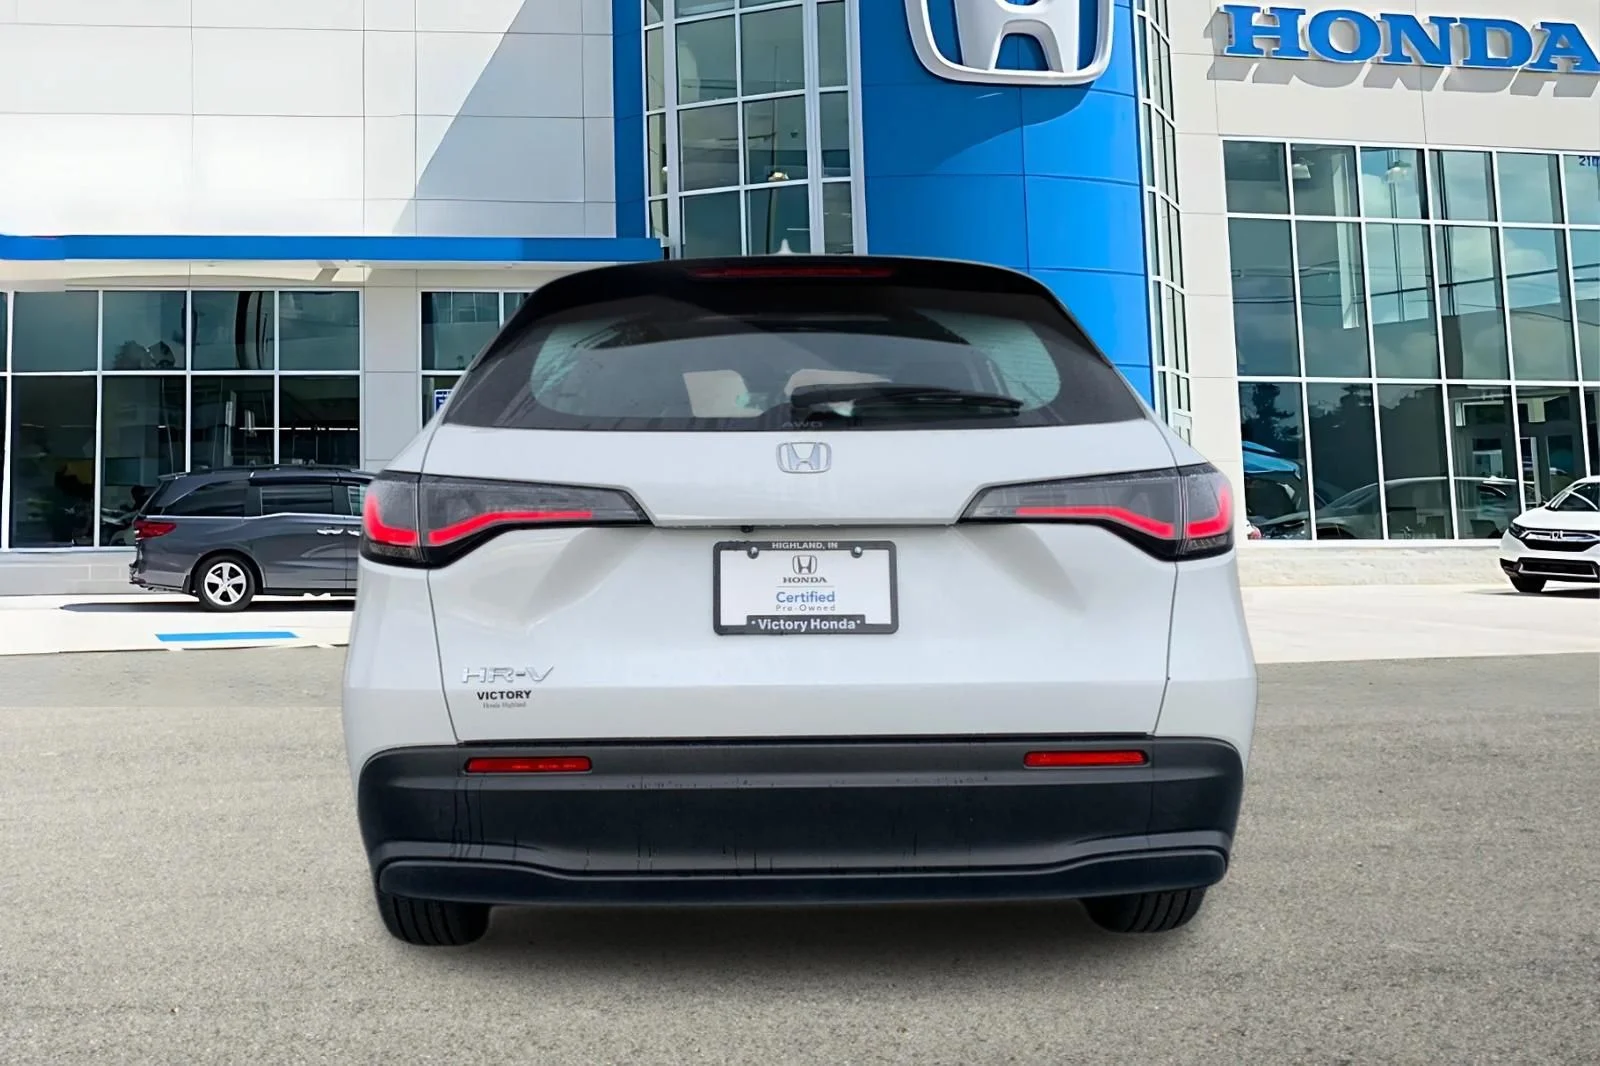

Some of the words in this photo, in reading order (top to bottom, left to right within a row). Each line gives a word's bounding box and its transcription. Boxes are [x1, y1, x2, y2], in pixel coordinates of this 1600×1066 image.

[1221, 4, 1600, 73] HONDA
[782, 420, 823, 428] AWD
[772, 542, 825, 550] HIGHLAND,
[776, 591, 836, 603] Certified
[776, 604, 836, 612] Pre-Owned
[758, 618, 807, 632] Victory
[811, 619, 856, 630] Honda
[461, 665, 554, 684] HR-V
[477, 690, 532, 700] VICTORY
